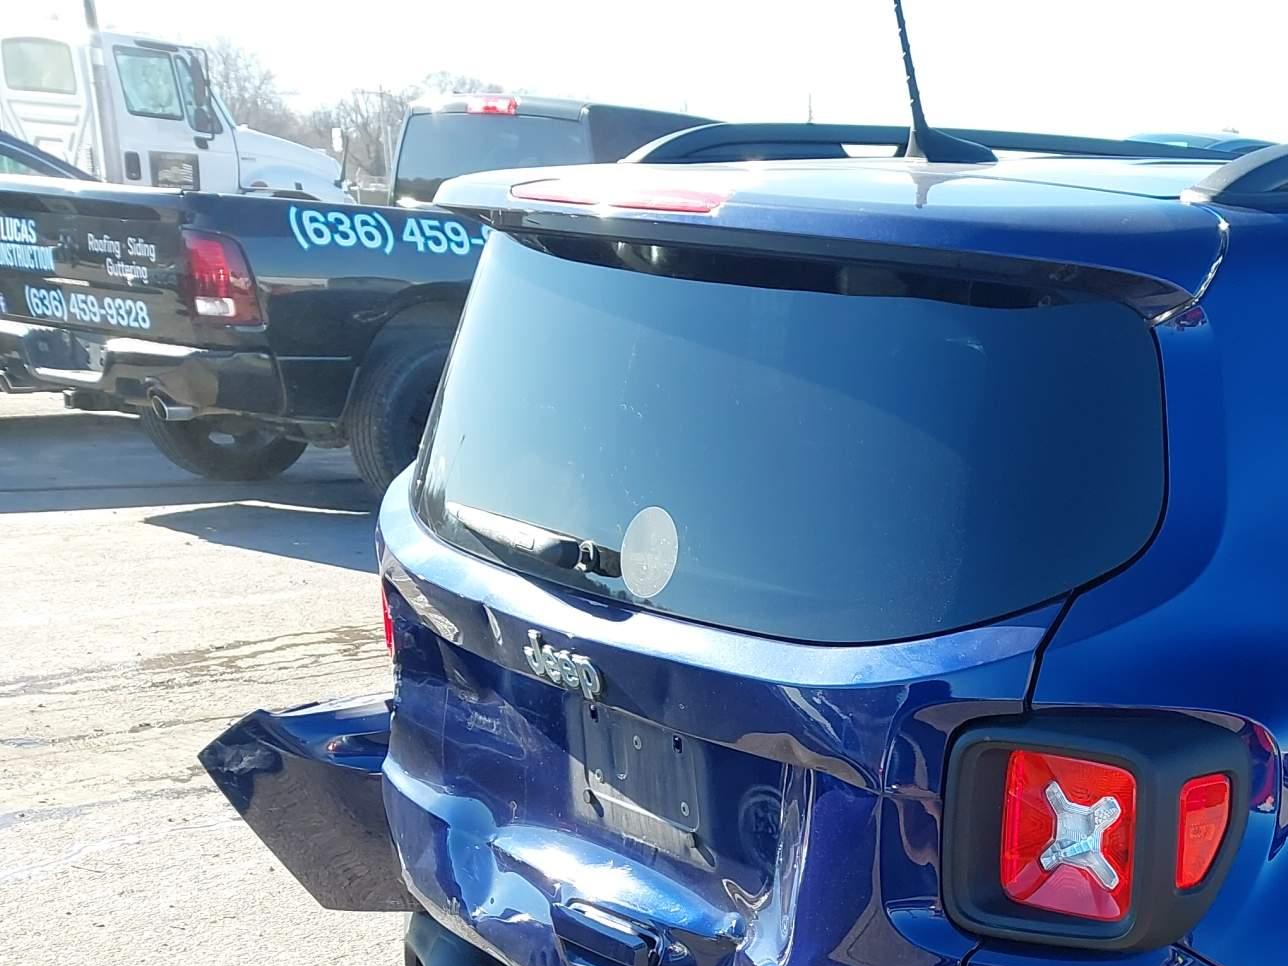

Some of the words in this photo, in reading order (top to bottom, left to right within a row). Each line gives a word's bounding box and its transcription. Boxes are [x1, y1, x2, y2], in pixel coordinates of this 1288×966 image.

[0, 216, 37, 243] LUCAS
[289, 206, 395, 255] (636)
[0, 242, 55, 271] NSTRUCTION
[87, 233, 121, 259] Roofing
[127, 237, 156, 262] Siding
[106, 258, 149, 287] Guttering
[25, 285, 68, 322] (636)
[69, 293, 151, 329] 459-9328
[524, 629, 601, 701] Jeep
